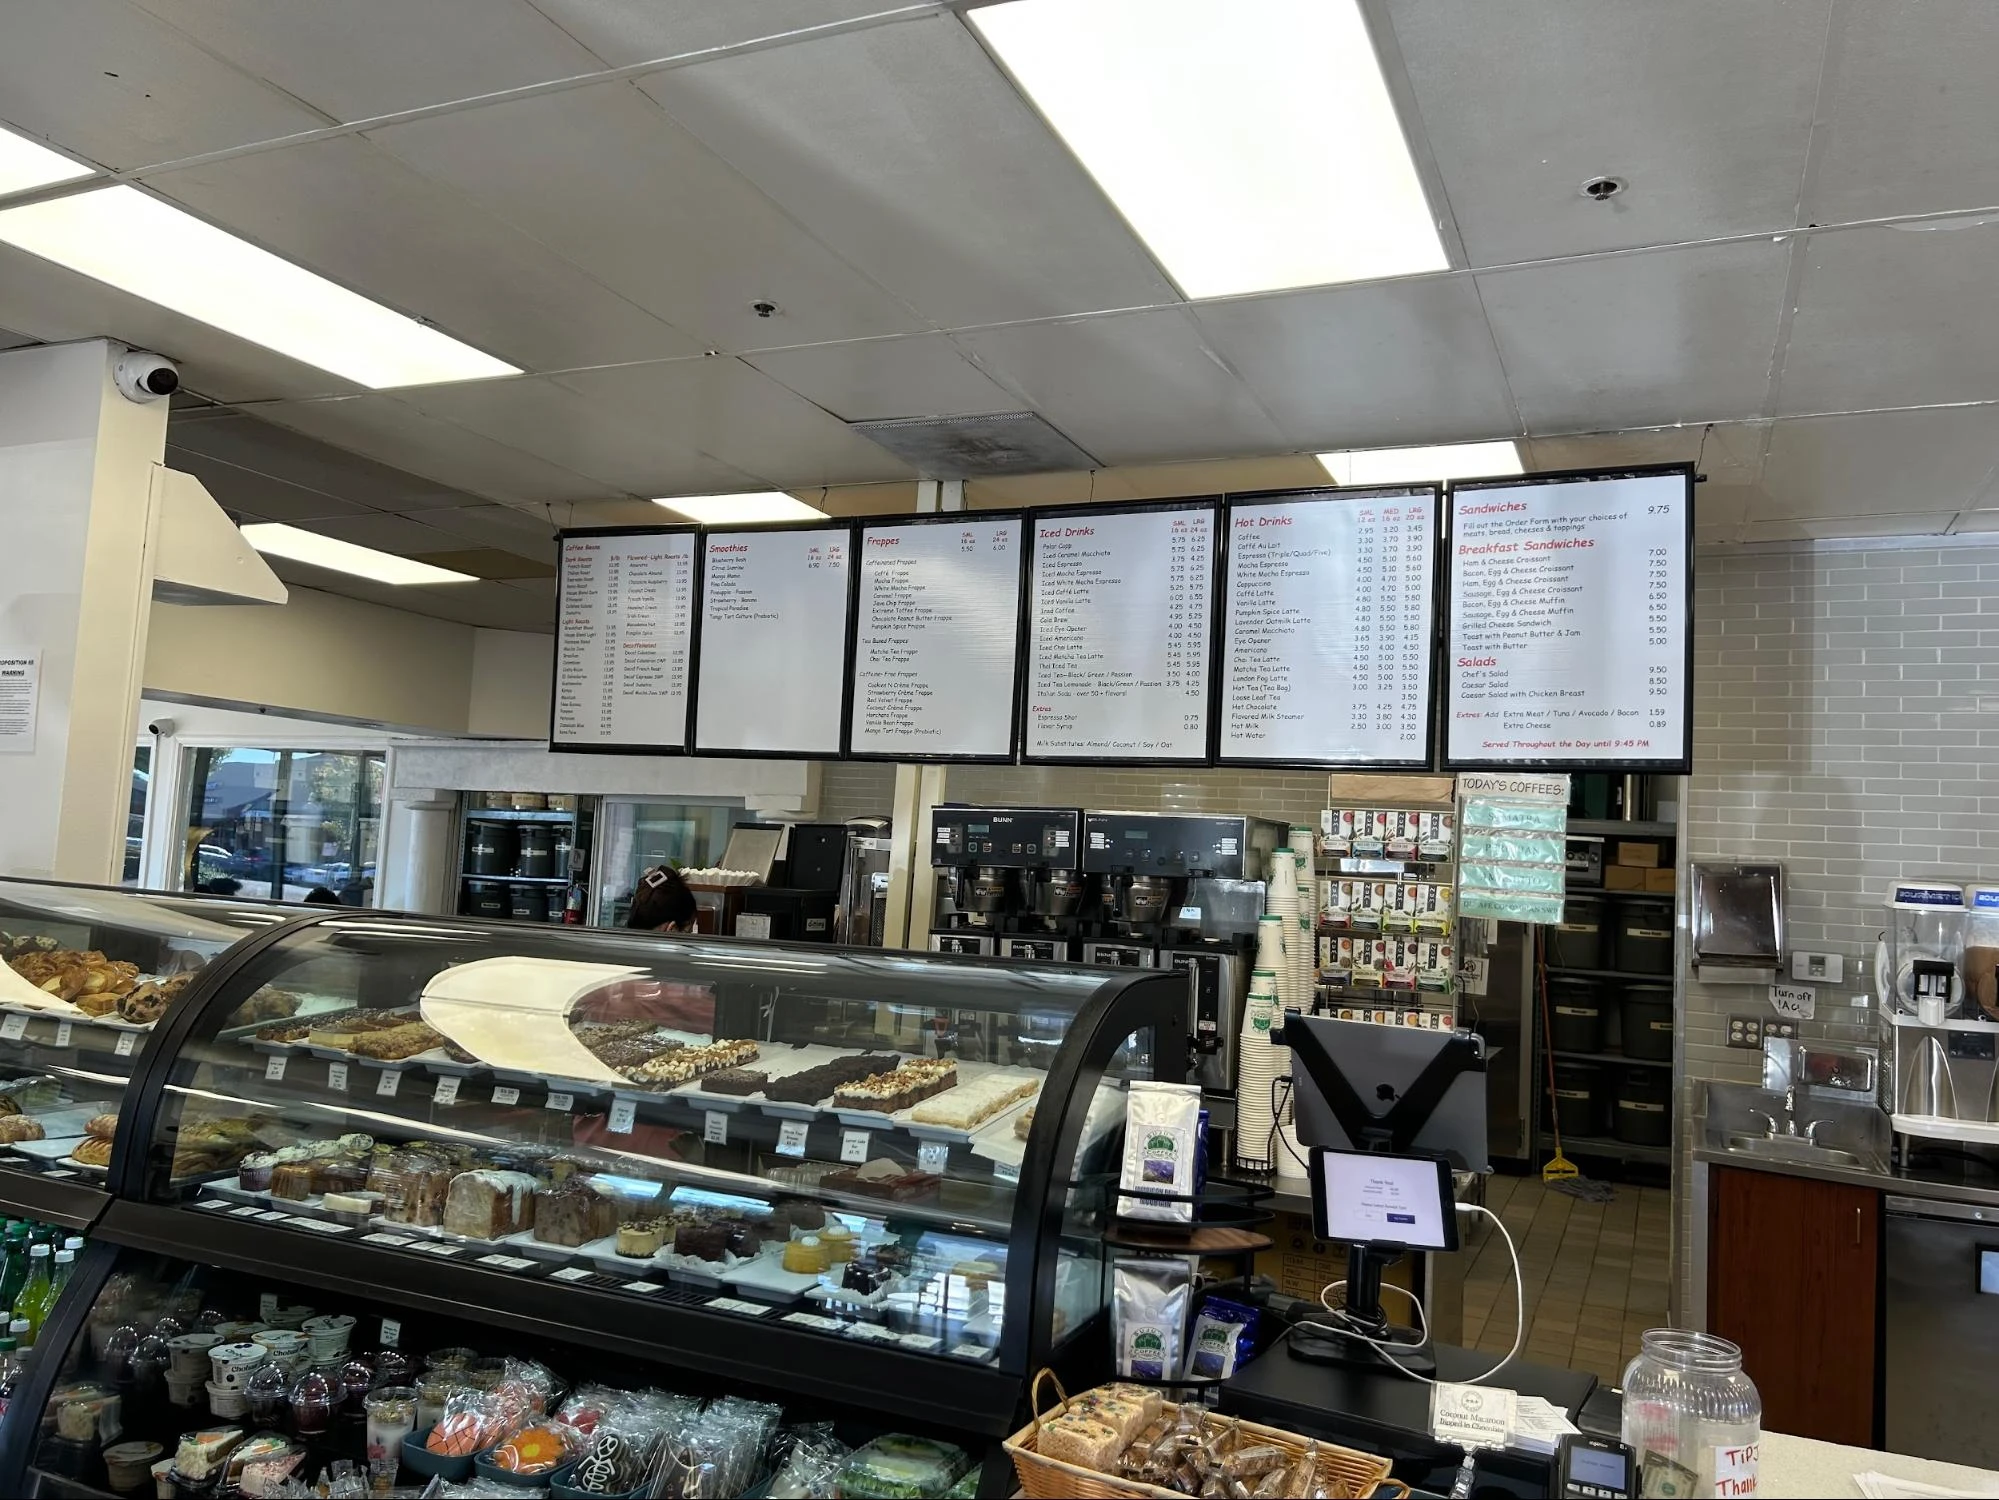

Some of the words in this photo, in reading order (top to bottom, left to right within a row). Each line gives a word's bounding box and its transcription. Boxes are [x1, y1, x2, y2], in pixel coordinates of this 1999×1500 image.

[1458, 501, 1527, 515] Sandwiches
[1647, 504, 1670, 514] 9.75
[1234, 517, 1254, 528] Hot
[1258, 515, 1292, 526] Drinks
[1550, 515, 1568, 523] with
[1567, 516, 1586, 525] your
[1588, 513, 1618, 521] choices
[1039, 527, 1062, 538] Iced
[1061, 526, 1094, 536] Drinks
[1514, 526, 1545, 534] cheeses
[1546, 524, 1551, 532] &
[1552, 524, 1585, 532] toppings
[866, 536, 900, 547] Frappes
[1458, 542, 1519, 554] Breakfast
[1523, 536, 1594, 550] Sandwiches
[708, 543, 748, 552] Smoothies
[1648, 547, 1666, 556] 7.00
[1259, 560, 1288, 569] Espresso
[1487, 556, 1515, 565] Cheese
[1515, 555, 1551, 564] Croissant
[1648, 558, 1667, 568] 7.50
[1280, 569, 1309, 577] Espresso
[1487, 568, 1501, 577] Egg
[1510, 566, 1537, 574] Cheese
[1538, 564, 1574, 573] Croissant
[1649, 569, 1666, 577] 7.50
[1236, 580, 1271, 590] Cappuccino
[1482, 579, 1496, 588] Egg
[1533, 575, 1569, 584] Croissant
[1649, 580, 1667, 588] 7.50
[1496, 588, 1510, 597] Egg
[1518, 586, 1547, 594] Cheese
[1547, 584, 1583, 595] Croissant
[1648, 591, 1666, 600] 6.50
[1236, 599, 1256, 607] Vanilla
[1487, 599, 1501, 608] Egg
[1538, 596, 1565, 604] Muffin
[1648, 602, 1667, 611] 6.50
[1234, 608, 1261, 617] Pumpkin
[1262, 608, 1280, 616] Spice
[1495, 609, 1510, 618] Egg
[1518, 608, 1545, 616] Cheese
[1648, 614, 1667, 622] 5.50
[1461, 621, 1487, 630] Grilled
[1516, 618, 1551, 627] Sandwich
[1648, 625, 1667, 634] 5.50
[1502, 631, 1528, 639] Peanut
[1484, 642, 1500, 650] with
[1648, 637, 1667, 645] 5.00
[1456, 656, 1496, 667] Salads
[1461, 670, 1486, 679] Chef's
[1487, 669, 1508, 677] Salad
[1648, 665, 1667, 674] 9.50
[1486, 680, 1508, 688] Salad
[1648, 676, 1667, 684] 8.50
[1460, 690, 1486, 698] Caesar
[1487, 690, 1508, 698] Salad
[1528, 689, 1557, 697] Chicken
[1648, 687, 1667, 695] 9.50
[1503, 710, 1524, 718] Extra
[1616, 708, 1639, 716] Bacon
[1511, 740, 1556, 749] Throughout
[1575, 740, 1592, 748] Day
[1463, 778, 1507, 791] TODAY'S
[1510, 781, 1565, 795] COFFEES:
[1771, 986, 1794, 998] Turn
[1797, 992, 1812, 1001] off
[1471, 1414, 1505, 1426] Macaroon
